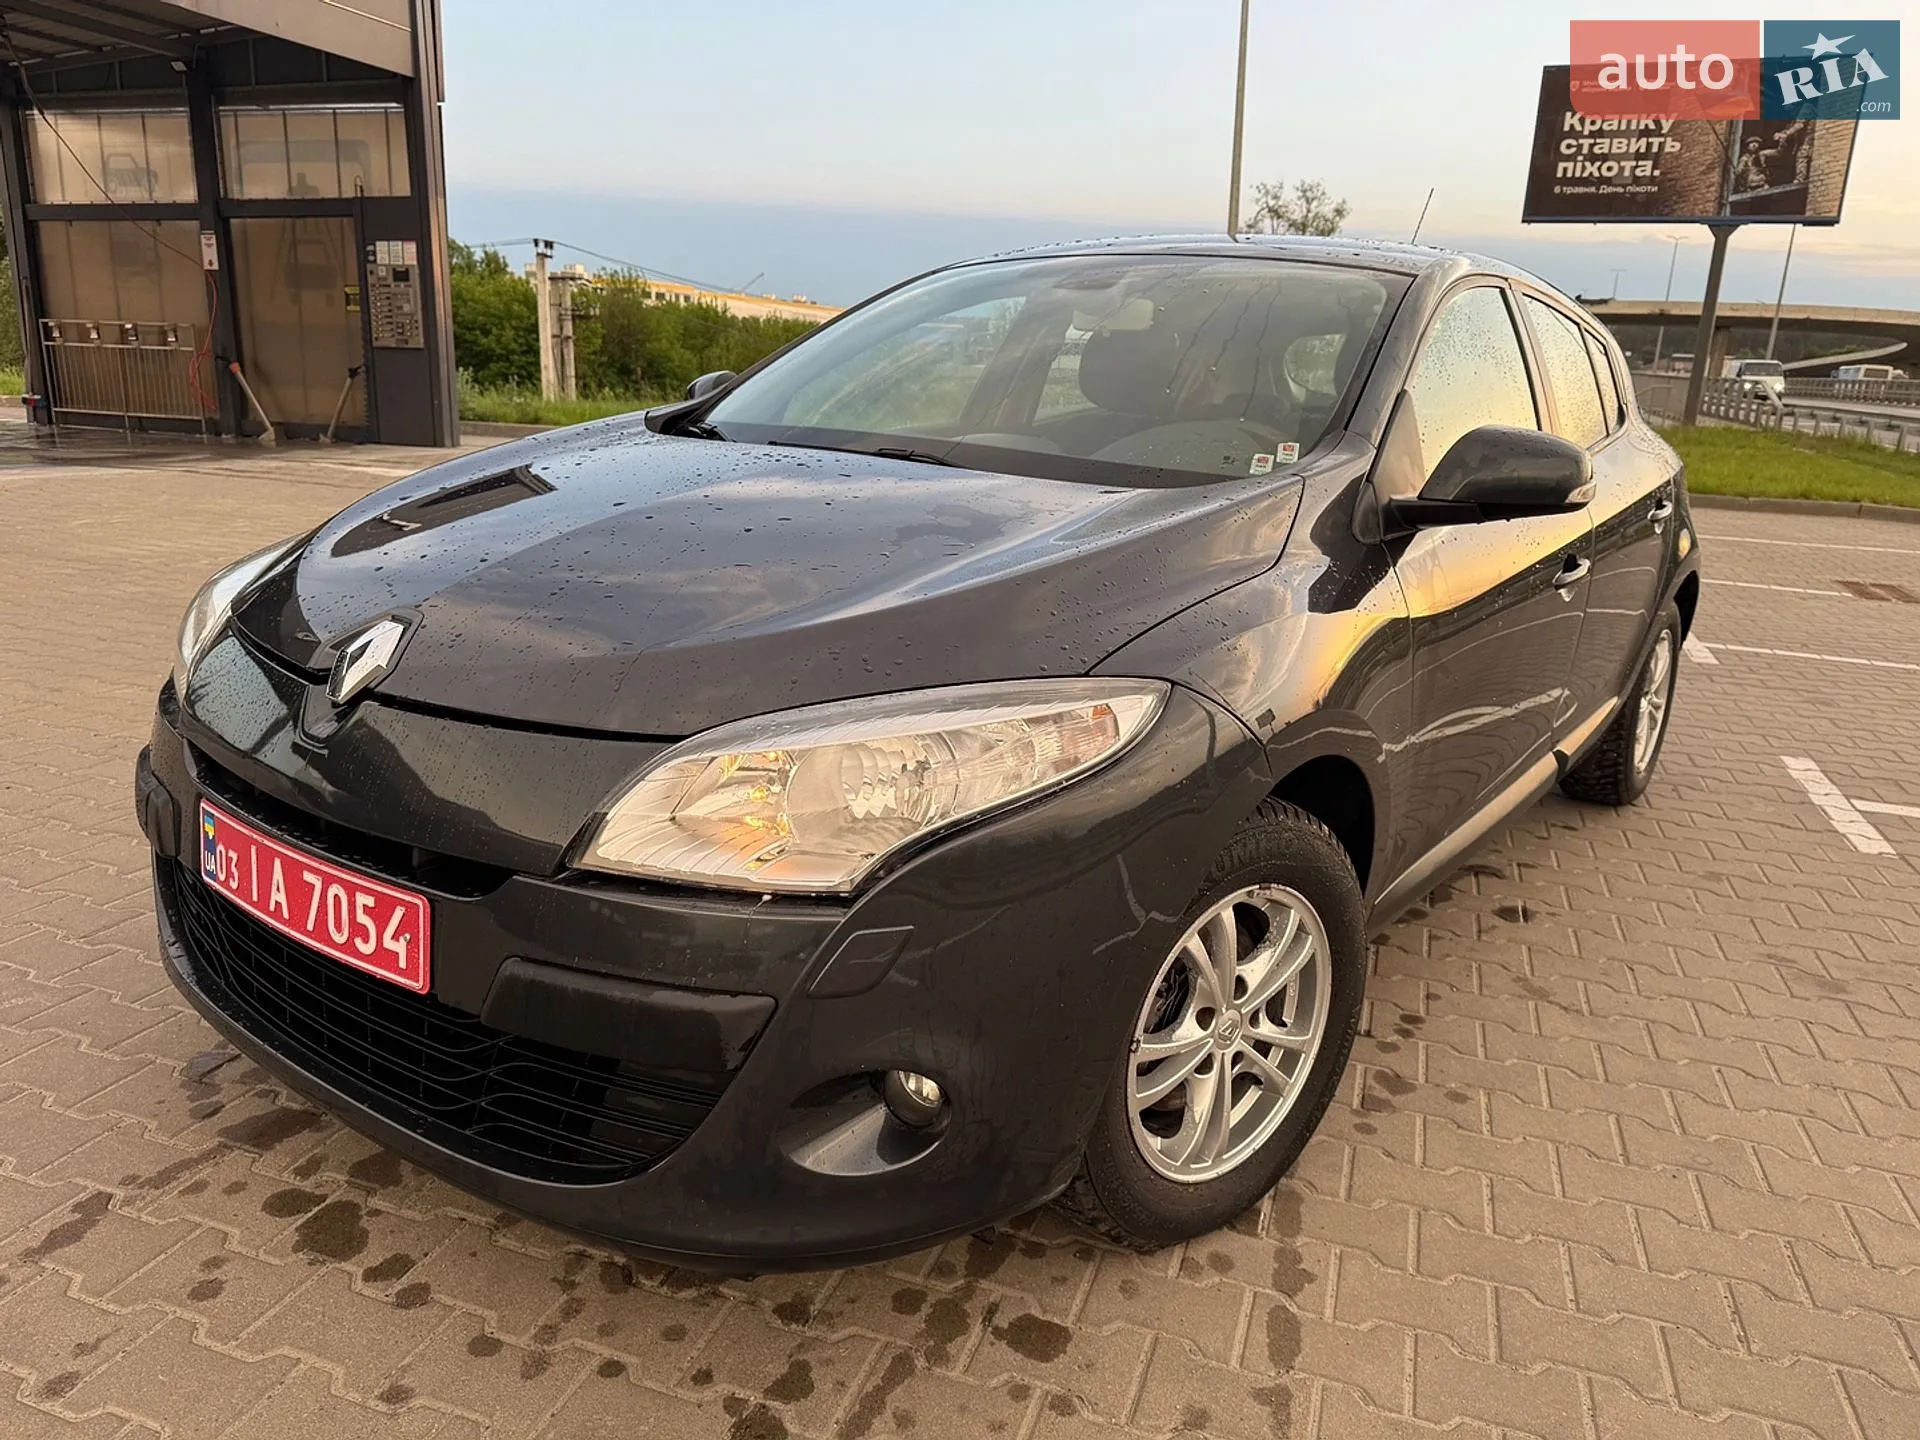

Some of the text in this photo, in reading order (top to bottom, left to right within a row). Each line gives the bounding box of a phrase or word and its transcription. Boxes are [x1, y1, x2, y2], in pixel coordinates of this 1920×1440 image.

[1563, 111, 1678, 135] Крапку
[1559, 136, 1682, 155] ставить
[1556, 156, 1661, 178] піхота.
[1598, 185, 1625, 195] День
[1626, 184, 1658, 194] піхоти
[204, 850, 216, 875] UA
[216, 843, 239, 890] 03
[302, 869, 411, 970] 7054
